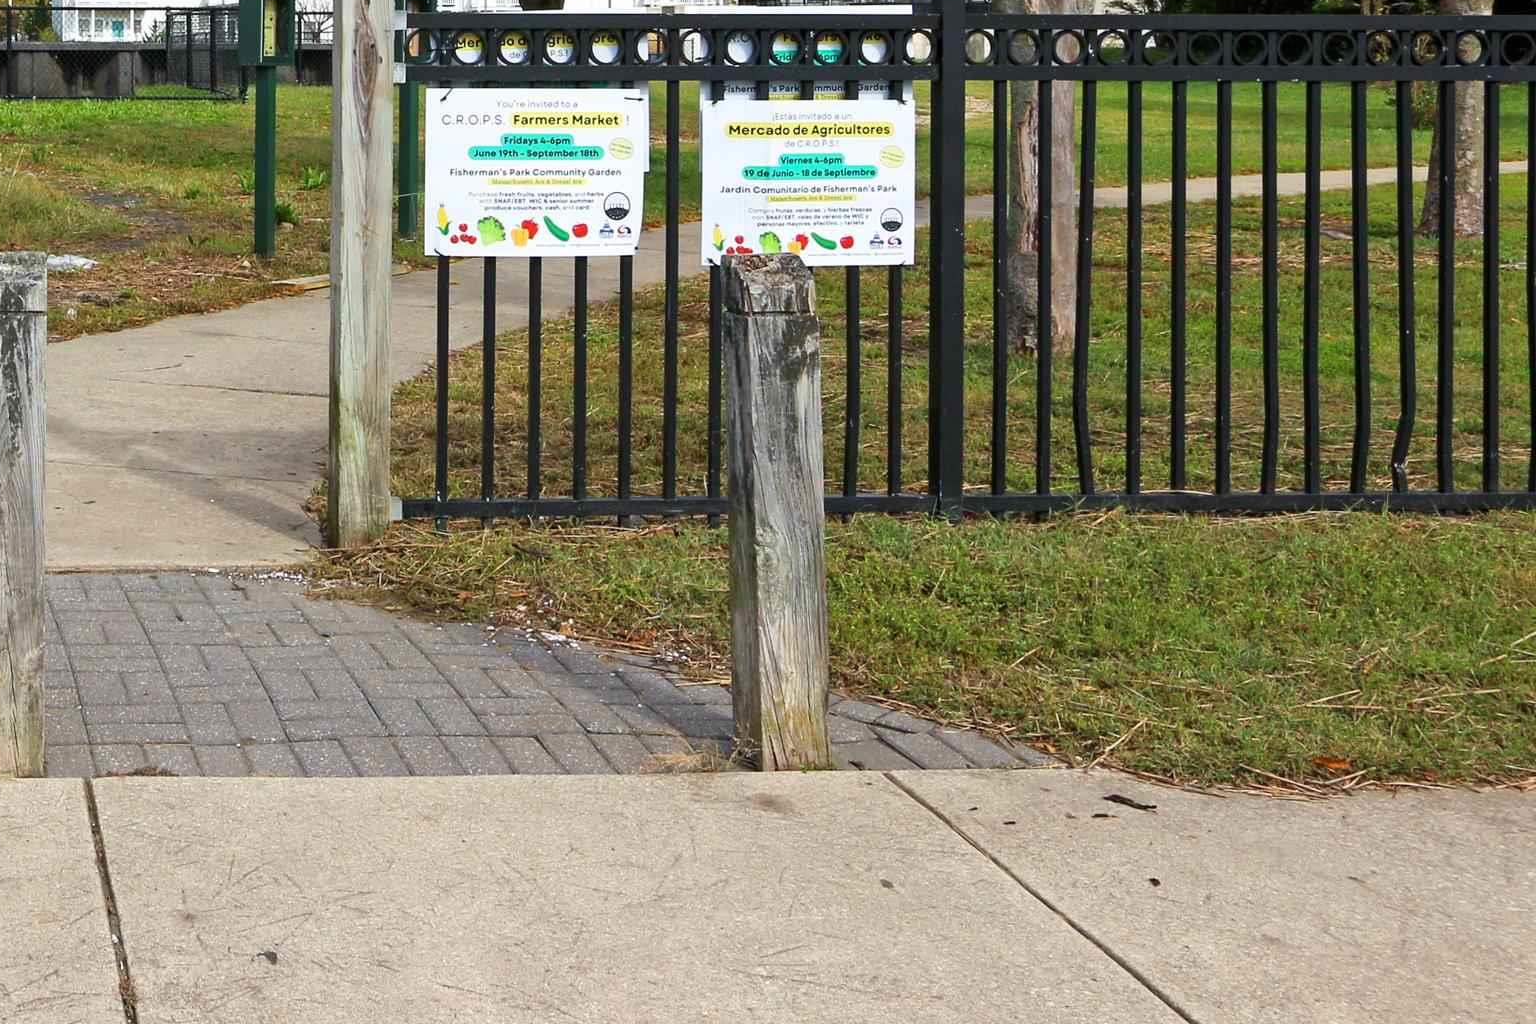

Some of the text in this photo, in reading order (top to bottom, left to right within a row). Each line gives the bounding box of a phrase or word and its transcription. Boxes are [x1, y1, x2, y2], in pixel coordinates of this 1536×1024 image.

[527, 100, 559, 108] invited
[442, 114, 506, 126] C.R.O.P.S.
[514, 115, 569, 125] Farmers
[573, 115, 619, 125] Market
[799, 112, 832, 120] invitado
[729, 124, 890, 137] Mercado de Agricultores
[504, 136, 571, 146] Fridays 4-6pm
[784, 140, 795, 148] de
[499, 149, 518, 157] 19th
[527, 149, 578, 159] September
[580, 149, 599, 157] 18th
[814, 157, 842, 166] 4-6pm
[450, 168, 621, 178] Fisherman's Park Community Garden
[744, 169, 755, 177] 19
[757, 169, 770, 177] de
[772, 169, 794, 177] Junio
[824, 169, 875, 178] Septiembre
[753, 186, 809, 194] Comunitario
